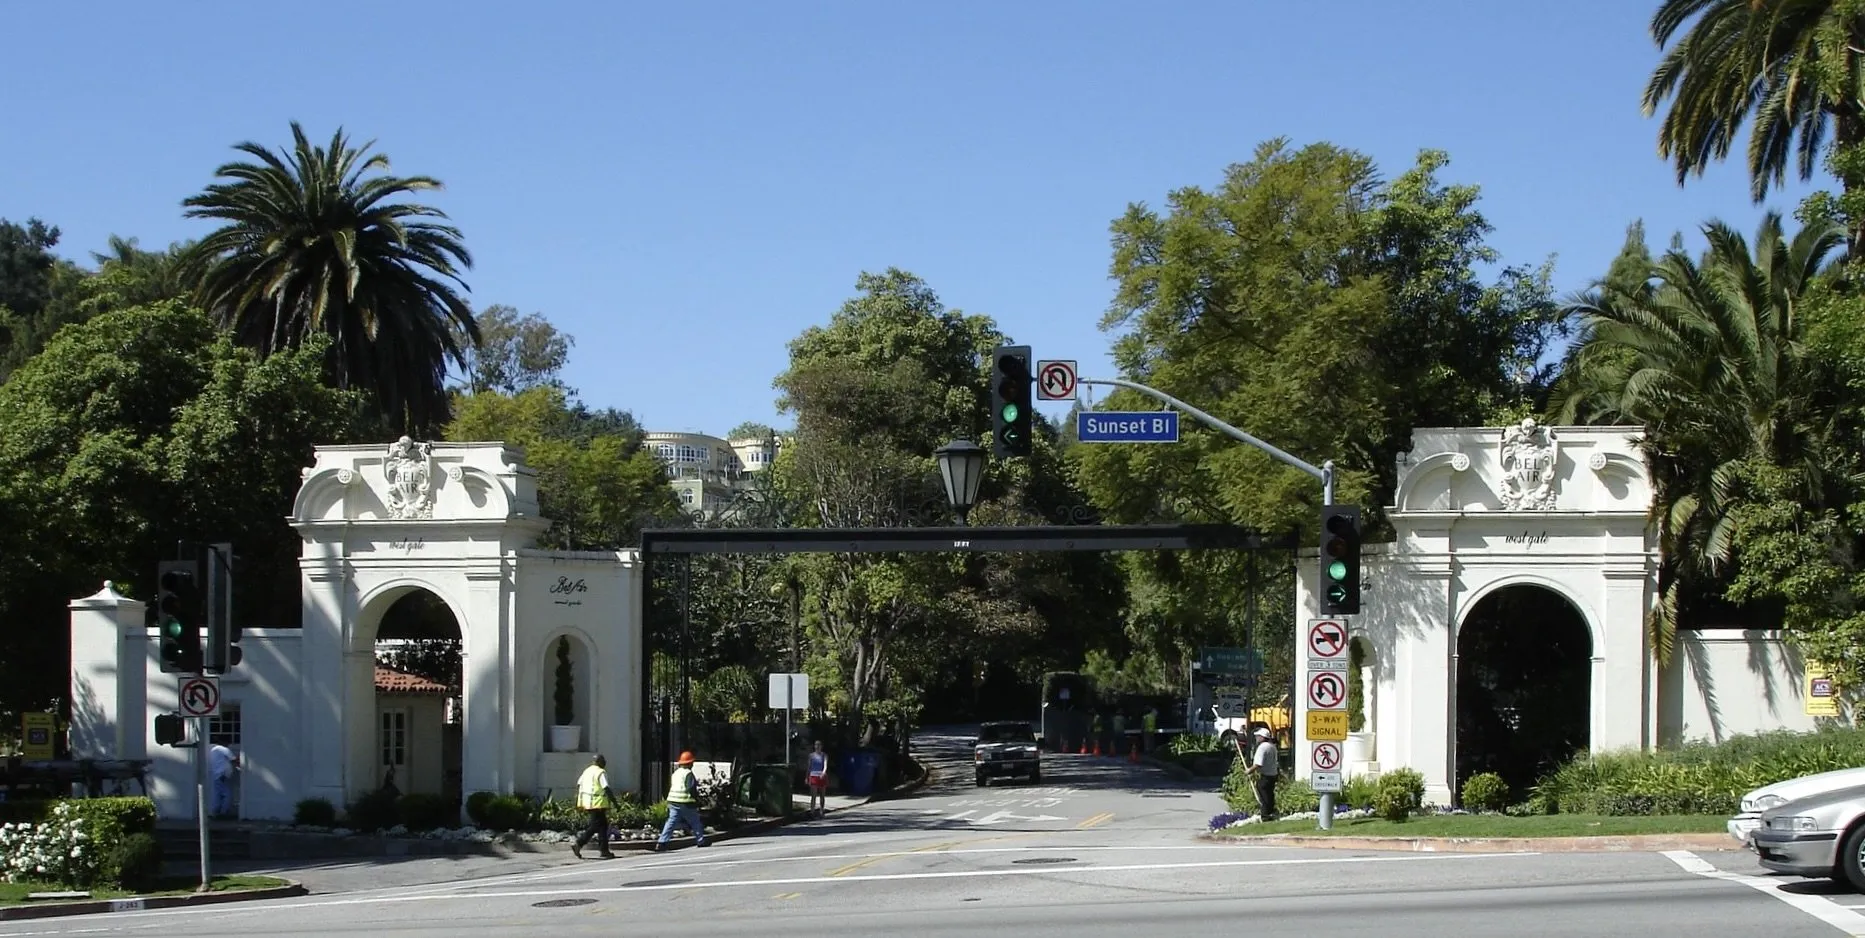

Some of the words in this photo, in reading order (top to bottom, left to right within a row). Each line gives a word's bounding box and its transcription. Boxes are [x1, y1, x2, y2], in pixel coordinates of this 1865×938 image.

[1087, 418, 1146, 434] Sunset
[1152, 418, 1170, 434] Bl
[1515, 457, 1541, 470] BEL
[397, 471, 420, 483] BEL
[1518, 470, 1540, 482] AIR
[400, 483, 418, 494] AIR
[1505, 530, 1528, 544] west
[1525, 530, 1549, 550] gate
[1312, 715, 1342, 724] 3-WAY
[1312, 727, 1342, 736] SIGNAL
